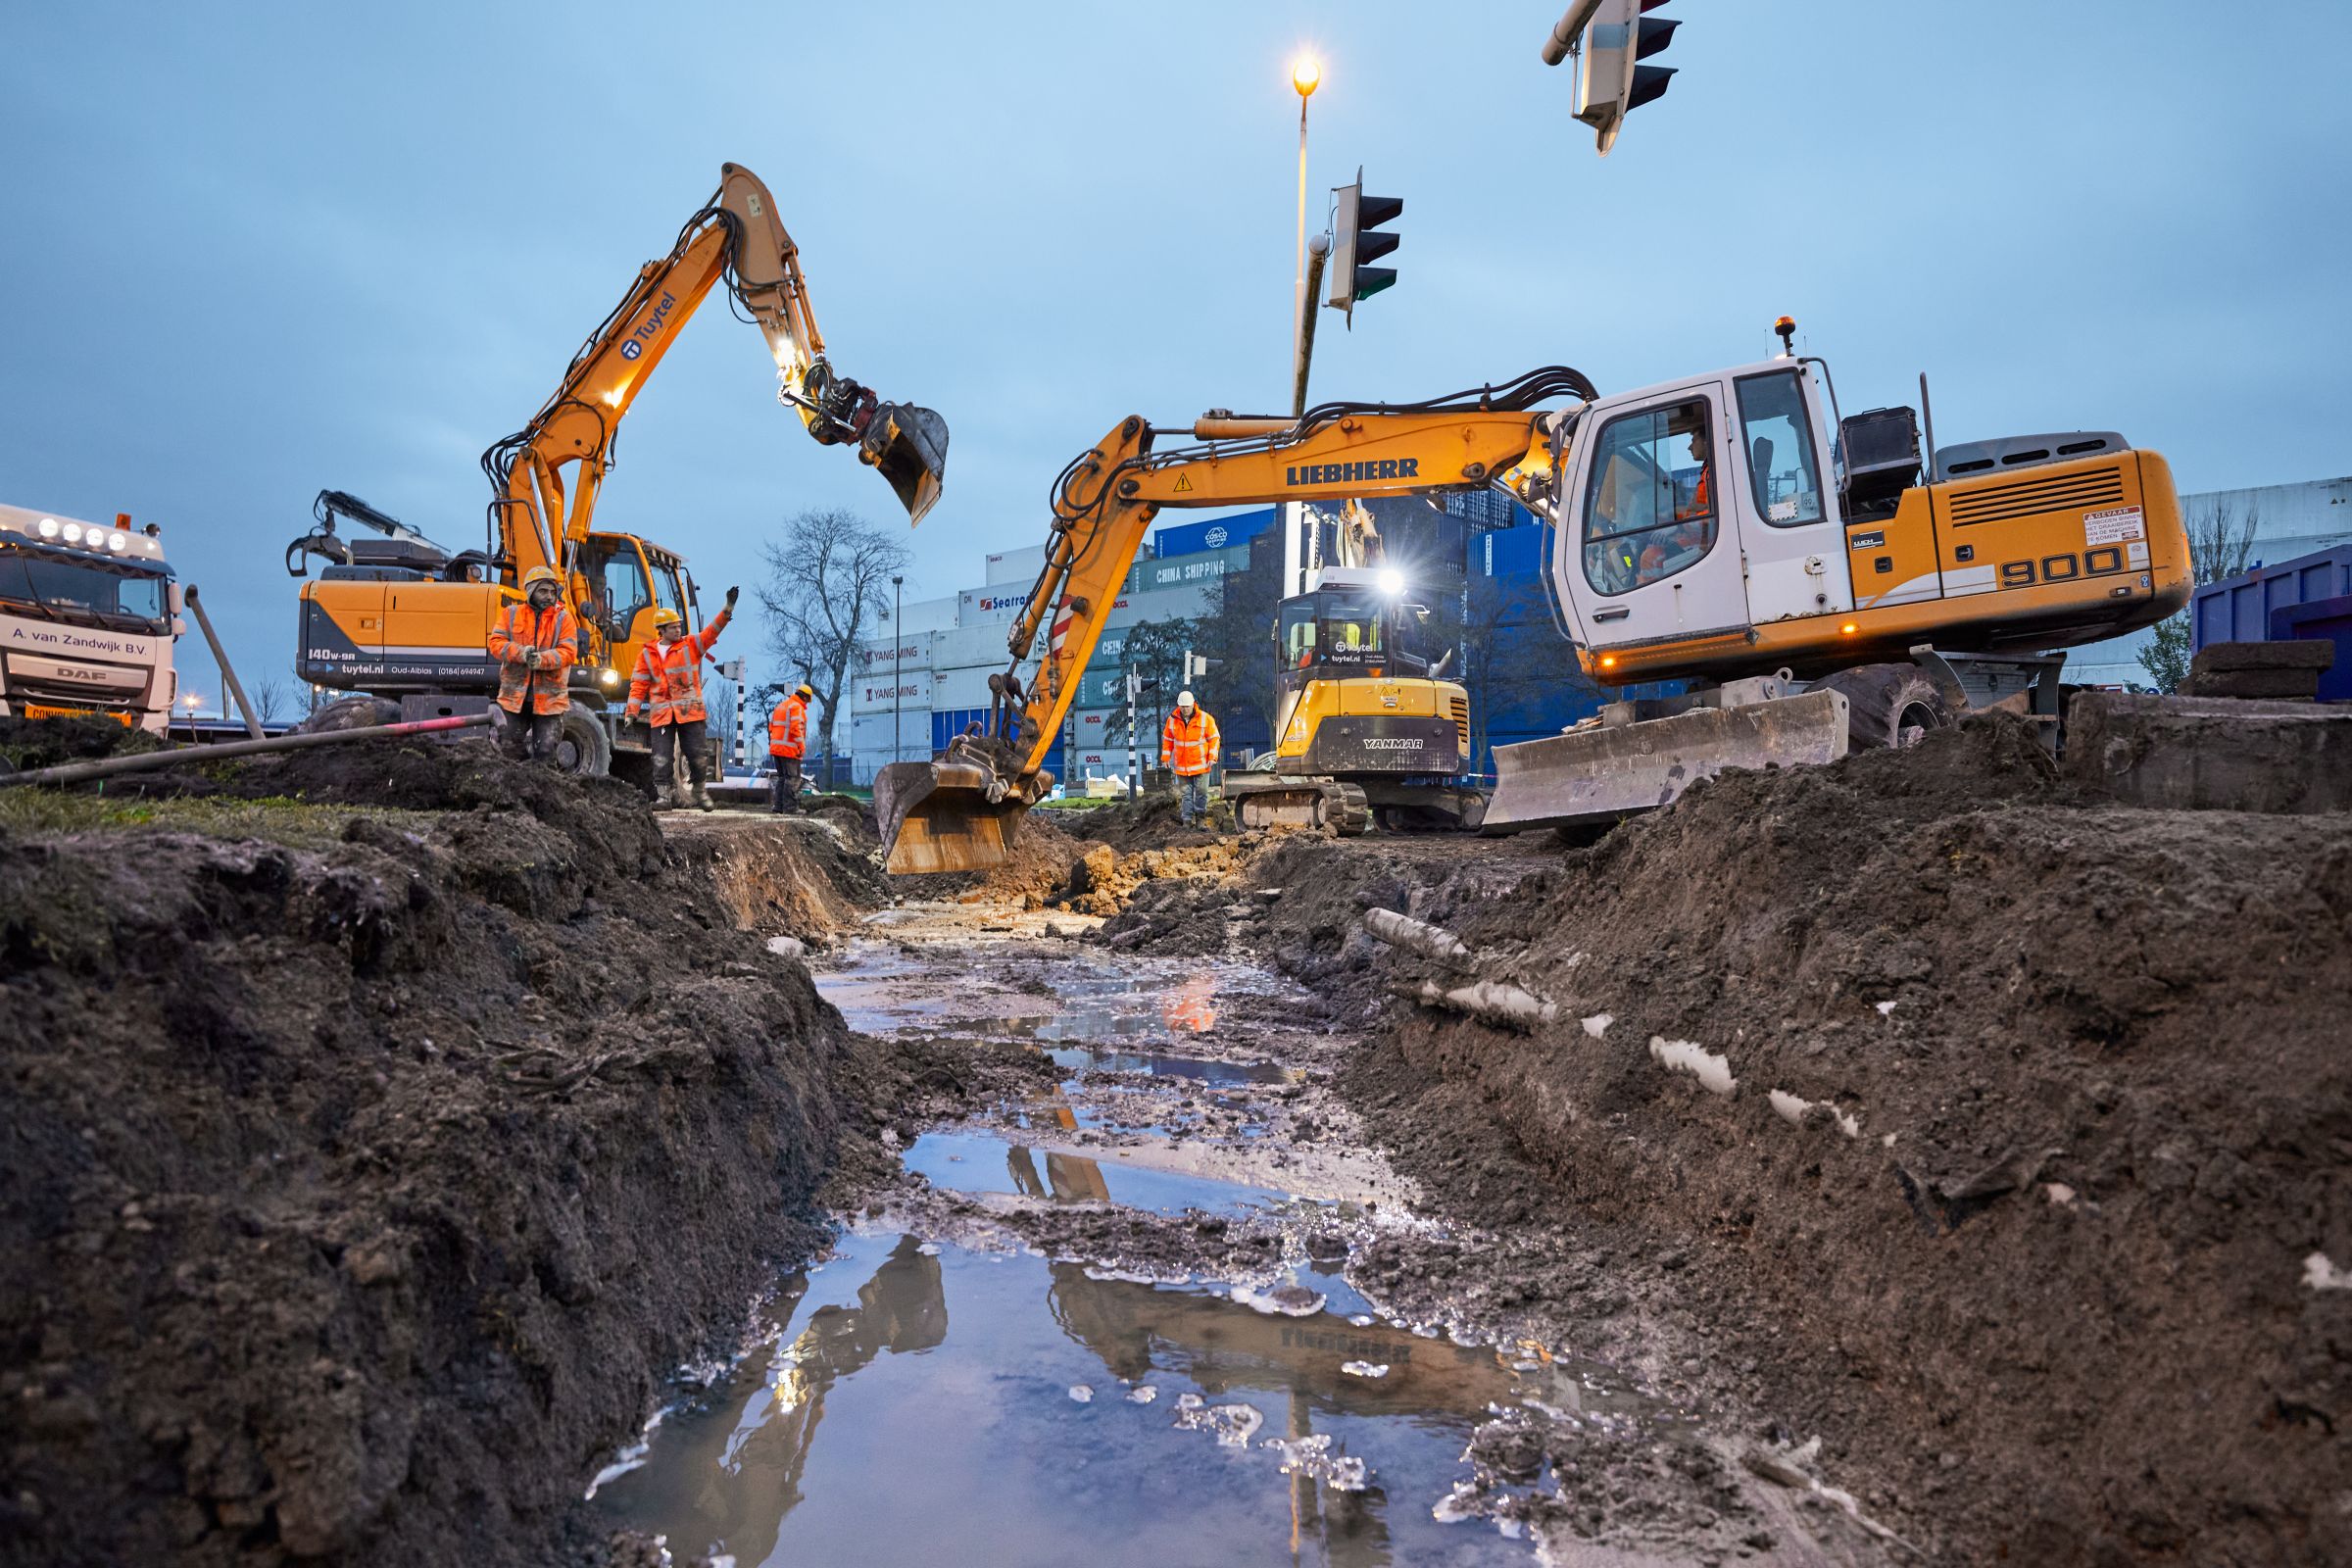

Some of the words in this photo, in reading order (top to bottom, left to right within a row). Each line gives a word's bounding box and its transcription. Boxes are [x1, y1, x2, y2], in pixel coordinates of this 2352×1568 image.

[634, 290, 676, 340] Tuytel
[1287, 458, 1419, 486] LIEBHERR
[2095, 509, 2129, 518] GEVAAR
[2085, 516, 2117, 526] VERBODEN
[1204, 531, 1228, 541] COSCO
[2095, 533, 2118, 542] KOMEN
[1156, 566, 1181, 583] CHINA
[1185, 560, 1225, 579] SHIPPING
[2000, 546, 2125, 588] 900
[993, 596, 1029, 609] Seatra
[13, 628, 26, 639] A.
[31, 632, 58, 643] van
[63, 634, 121, 653] Zandwijk
[125, 643, 147, 656] B.V.
[874, 649, 895, 662] YANG
[897, 646, 917, 659] MING
[1332, 654, 1360, 665] tuytel.nl
[57, 667, 106, 680] DAF
[341, 663, 384, 676] tuytel.nl
[391, 665, 433, 675] Oud-Alblas
[438, 666, 460, 676] (0184)
[460, 667, 485, 676] 694947
[874, 687, 895, 700] YANG
[897, 685, 917, 697] MING
[1363, 738, 1423, 750] YANMAR
